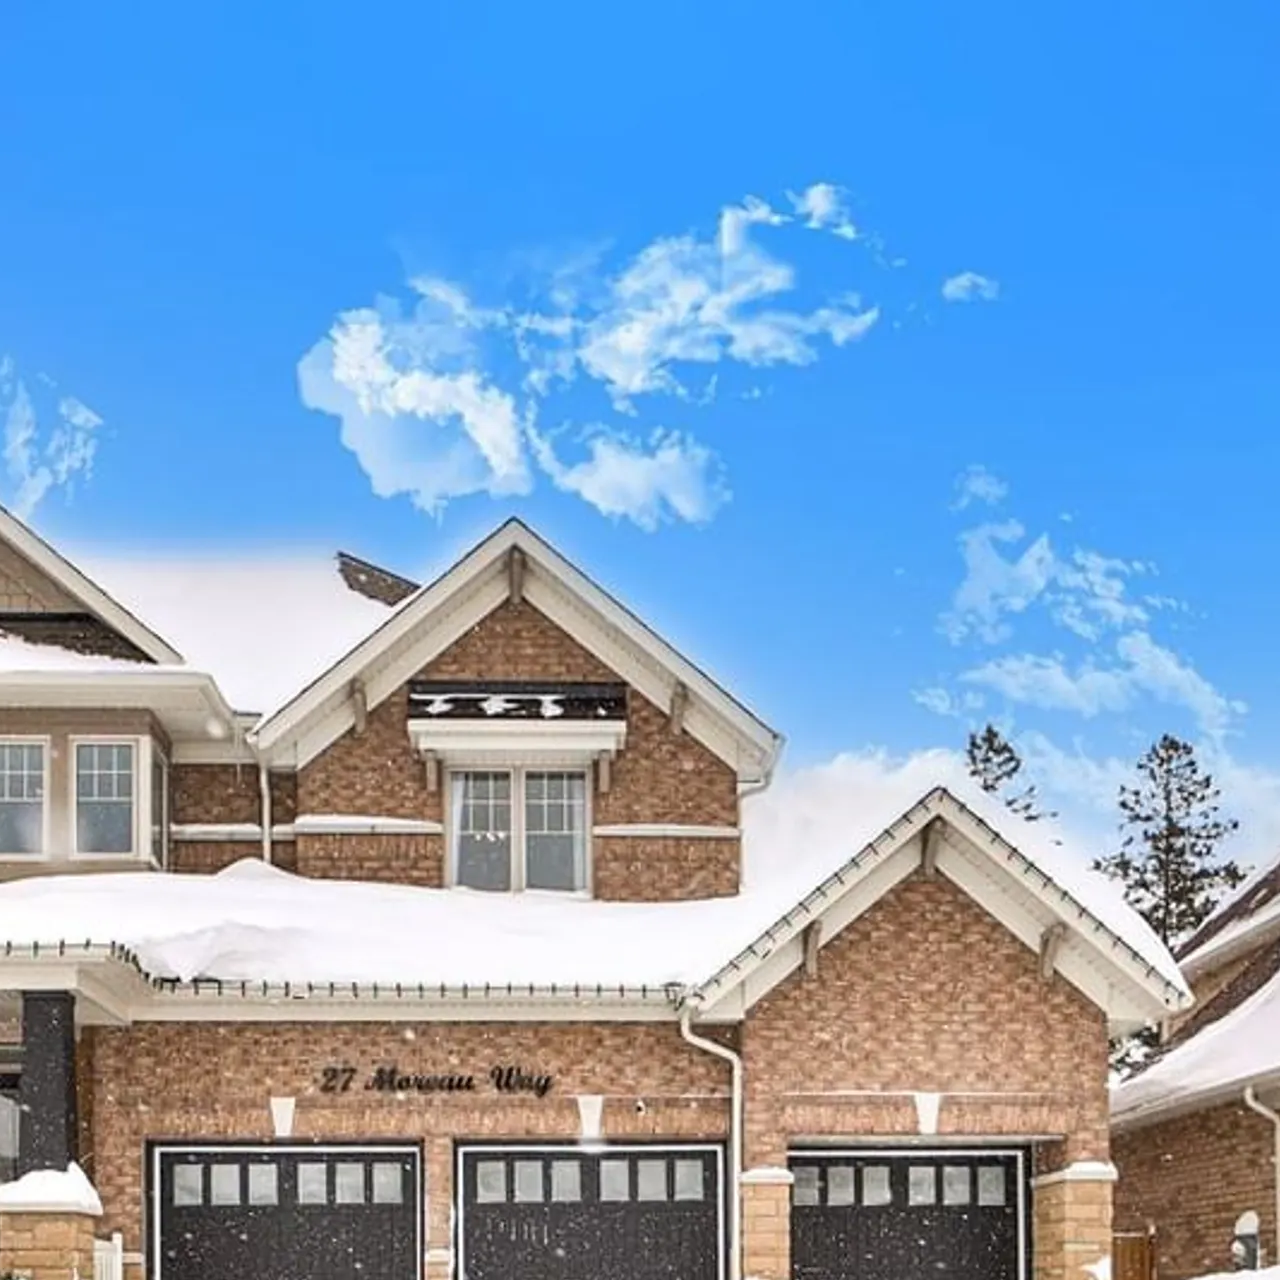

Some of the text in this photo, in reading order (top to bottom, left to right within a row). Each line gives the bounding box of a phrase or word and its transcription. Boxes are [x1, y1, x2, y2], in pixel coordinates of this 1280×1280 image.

[320, 1065, 554, 1099] 27 Moreau Way
